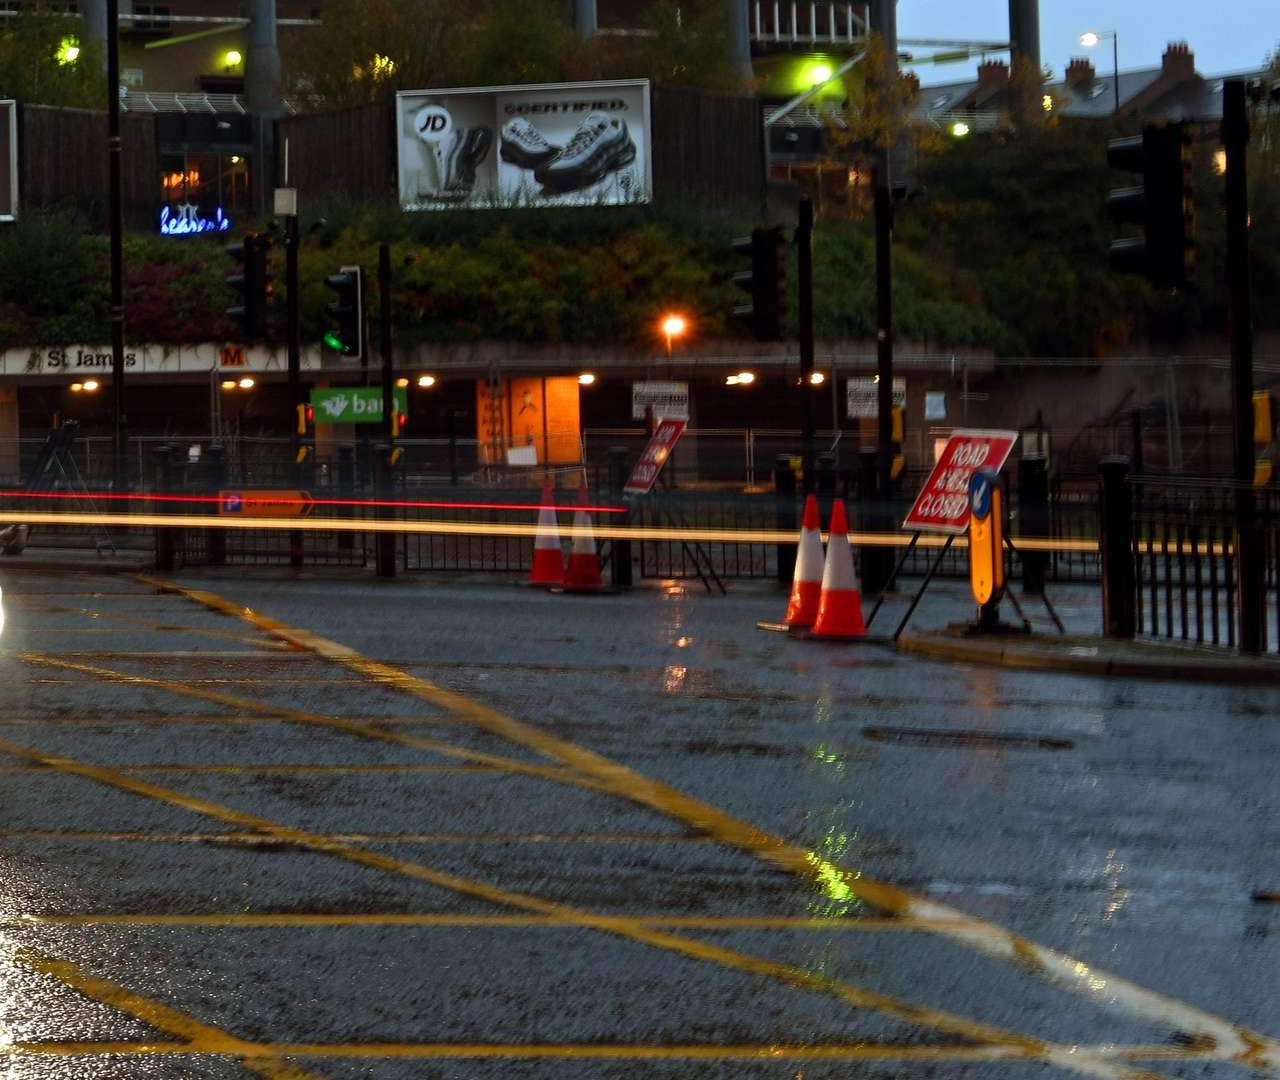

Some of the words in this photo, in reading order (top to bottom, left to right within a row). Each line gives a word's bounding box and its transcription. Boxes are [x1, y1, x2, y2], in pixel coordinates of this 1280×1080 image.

[419, 115, 447, 133] JD
[47, 350, 67, 367] St
[76, 350, 137, 367] Jams
[224, 349, 243, 365] M
[948, 442, 990, 468] ROAD
[933, 468, 969, 491] AHEA
[917, 493, 969, 520] CLOSED
